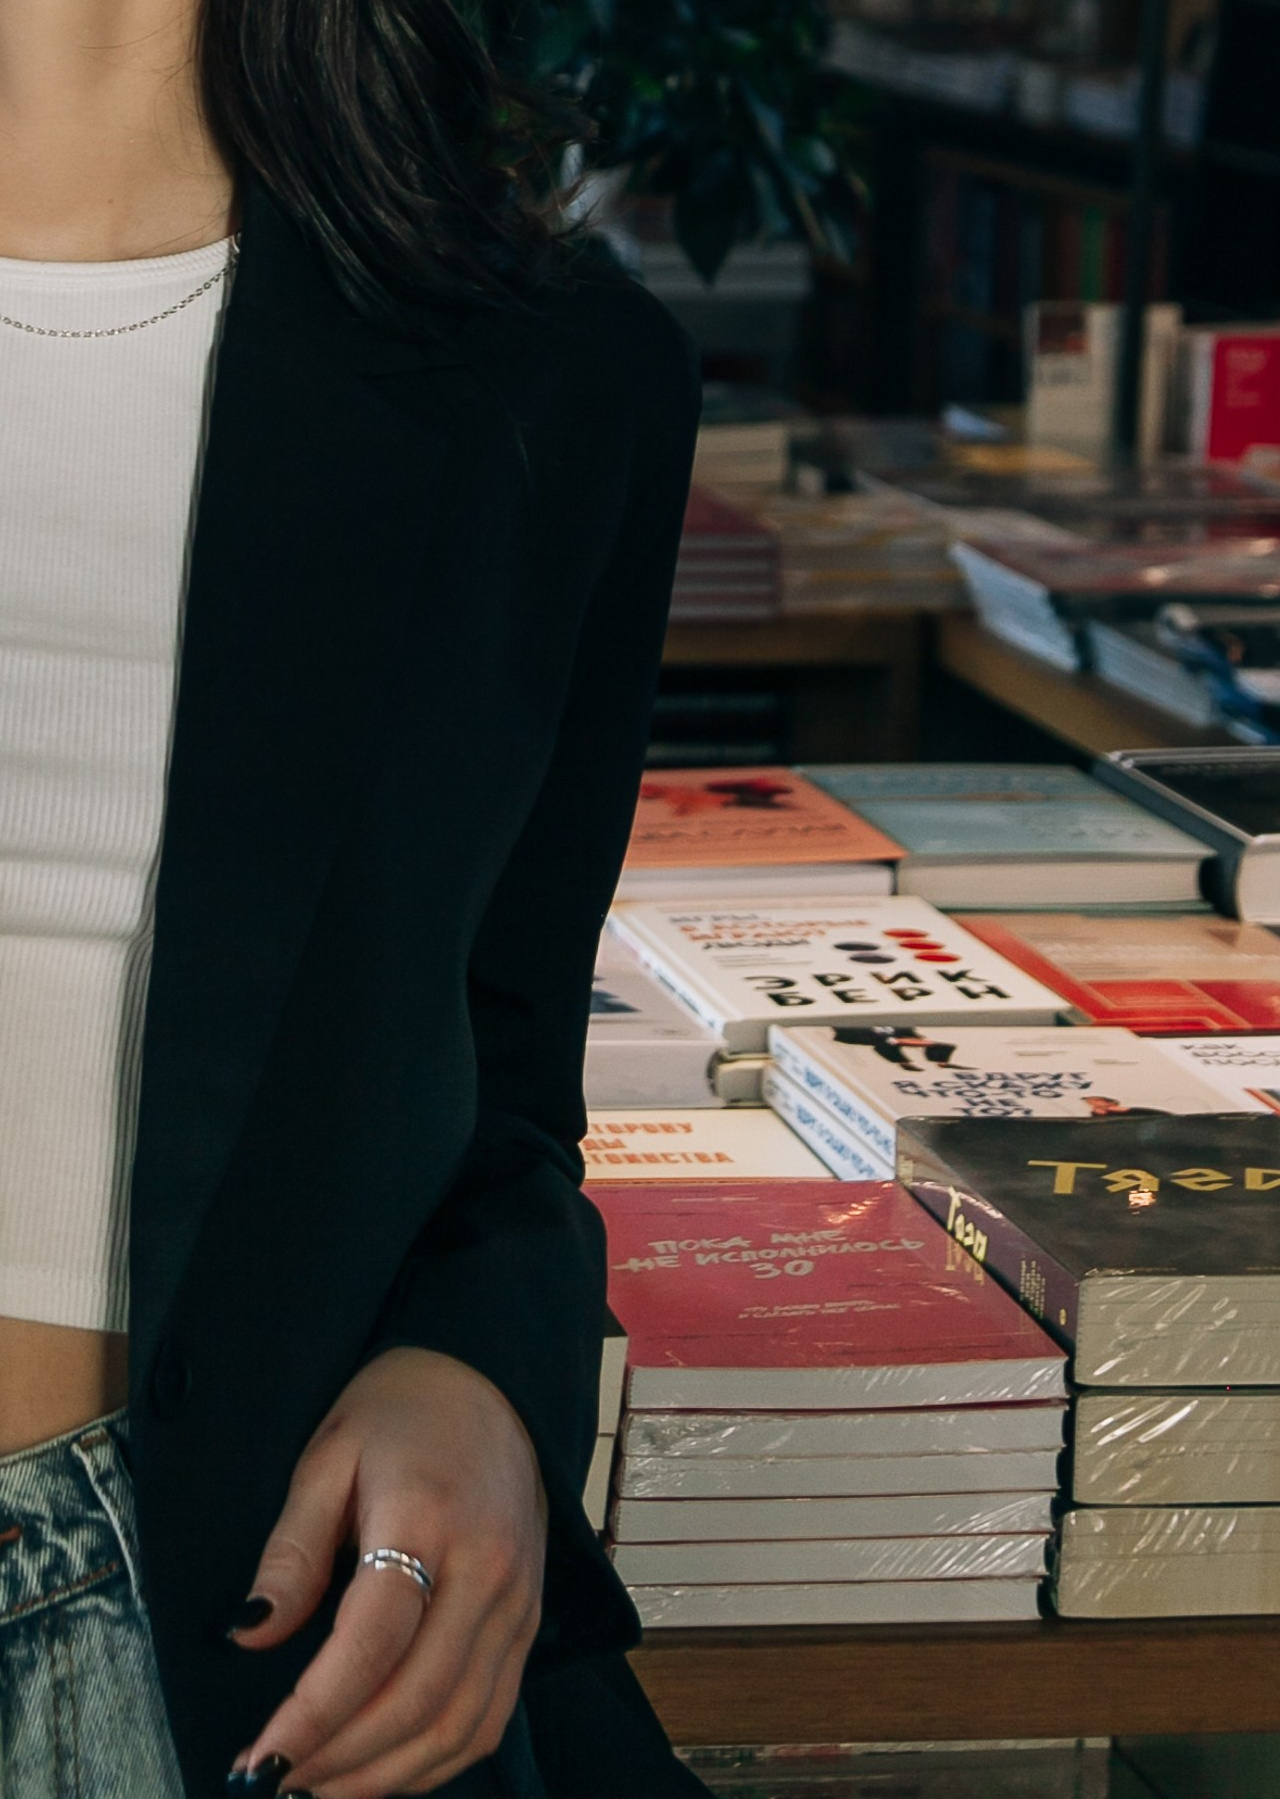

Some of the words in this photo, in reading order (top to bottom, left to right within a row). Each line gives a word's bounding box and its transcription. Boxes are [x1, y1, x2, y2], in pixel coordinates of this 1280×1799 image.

[743, 969, 989, 991] ЭРИК
[767, 983, 1013, 1007] БЕРН
[588, 1122, 694, 1134] ТОРОНУ
[586, 1152, 735, 1164] ТОИНСТВА
[648, 1236, 752, 1254] ПОКА
[770, 1230, 848, 1244] МНЕ
[612, 1254, 682, 1273] НЕ
[694, 1238, 925, 1266] ИСПОЛНИЛОСЬ
[750, 1259, 814, 1279] 30
